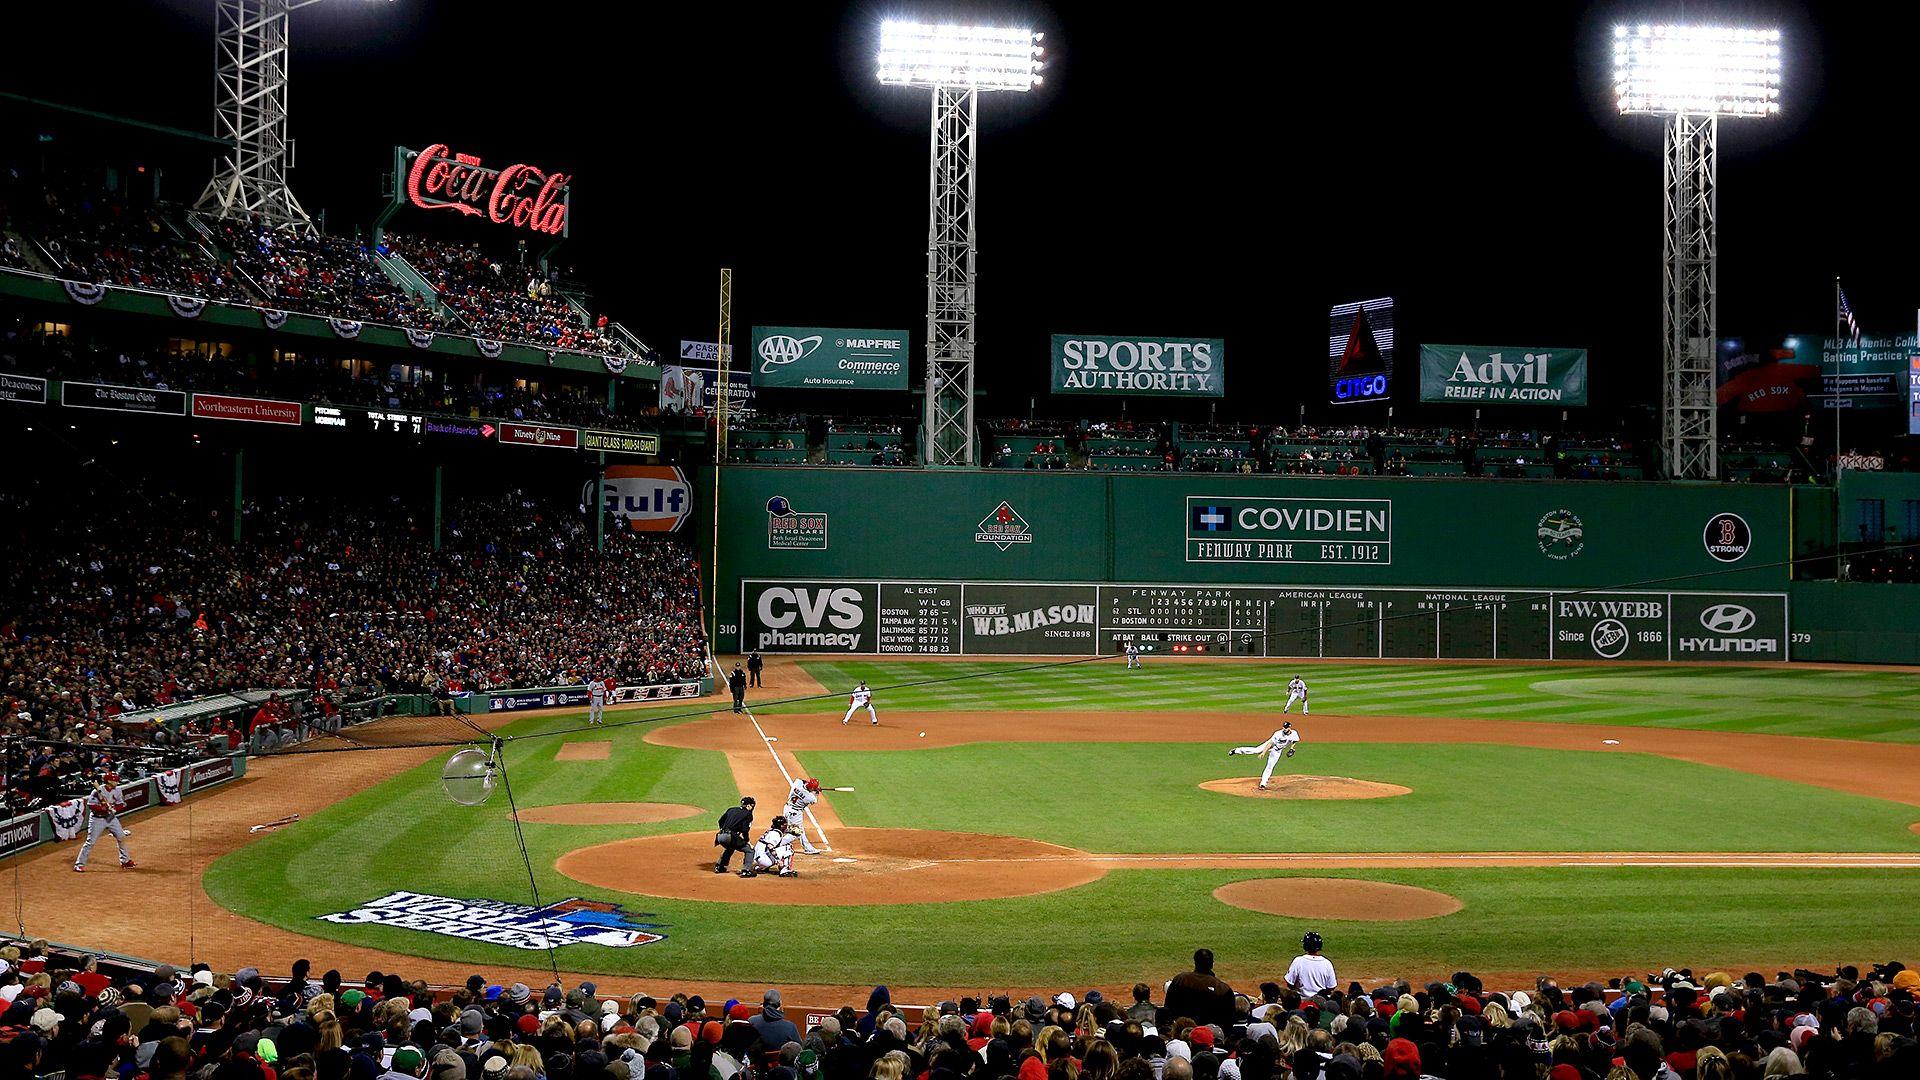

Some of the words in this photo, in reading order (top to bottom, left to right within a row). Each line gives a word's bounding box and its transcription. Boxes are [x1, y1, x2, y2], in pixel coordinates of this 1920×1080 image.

[846, 339, 901, 349] MAPFRE
[1823, 338, 1844, 349] MLB
[1845, 336, 1892, 349] Auhentic
[763, 337, 801, 362] AAA
[1063, 340, 1212, 372] SPORTS
[1823, 351, 1858, 364] Batting
[1860, 349, 1902, 361] Practice
[838, 359, 901, 371] Commerce
[1446, 351, 1551, 385] Advil
[0, 377, 42, 391] Deaconess
[803, 377, 820, 385] Auto
[822, 377, 855, 385] Insurance
[1063, 371, 1211, 391] AUTHORITY
[1336, 375, 1387, 399] CITGO
[95, 388, 108, 399] The
[110, 389, 135, 401] Boston
[136, 391, 156, 402] Globe
[1444, 386, 1496, 398] RELIEF
[1500, 387, 1516, 399] IN
[1518, 388, 1561, 400] ACTION
[1748, 388, 1766, 402] RED
[1770, 386, 1789, 395] SOX
[198, 400, 253, 414] Northeastern
[255, 405, 297, 421] University
[367, 411, 386, 420] TOTAL
[373, 420, 379, 430] 7
[393, 421, 400, 432] 5
[514, 429, 535, 440] Ninety
[546, 432, 561, 442] Nine
[586, 434, 603, 447] GIANT
[603, 436, 620, 449] GLASS
[640, 439, 655, 452] GIANT
[603, 484, 684, 512] Gulf
[772, 517, 798, 529] RED
[799, 517, 824, 529] SOX
[1238, 506, 1386, 533] COVIDIEN
[977, 534, 1031, 542] FOUNDATION
[1719, 519, 1736, 545] B
[1198, 542, 1252, 559] FENWAY
[1258, 542, 1294, 560] PARK
[1351, 545, 1380, 560] 1912
[1710, 545, 1746, 553] STRONG
[903, 587, 915, 595] AL
[918, 587, 938, 595] EAST
[1132, 589, 1186, 597] FENWAY
[1279, 591, 1325, 599] AMERICAN
[757, 586, 864, 630] CVS
[918, 599, 929, 607] W
[931, 599, 937, 607] L
[940, 599, 951, 607] GB
[1558, 600, 1598, 618] F.W.
[1600, 601, 1663, 618] WEBB
[881, 608, 909, 616] BOSTON
[967, 606, 987, 615] WHO
[989, 606, 1006, 615] BUT
[1127, 607, 1142, 615] STL
[881, 617, 902, 625] TAMPA
[1121, 617, 1147, 625] BOSTON
[719, 624, 738, 636] 310
[881, 626, 916, 634] BALTIMORE
[929, 627, 939, 635] 77
[941, 627, 949, 635] 12
[1044, 630, 1070, 638] SINCE
[1072, 630, 1091, 638] 1898
[1559, 630, 1585, 642] Since
[1637, 631, 1662, 642] 1866
[758, 629, 862, 651] pharmacy
[941, 636, 949, 644] 12
[1167, 634, 1192, 642] STRIKE
[1195, 634, 1211, 642] OUT
[1791, 633, 1811, 643] 379
[918, 645, 928, 653] 74
[940, 645, 950, 653] 23
[1679, 637, 1777, 652] HYUNDAI
[808, 1015, 820, 1025] BE
